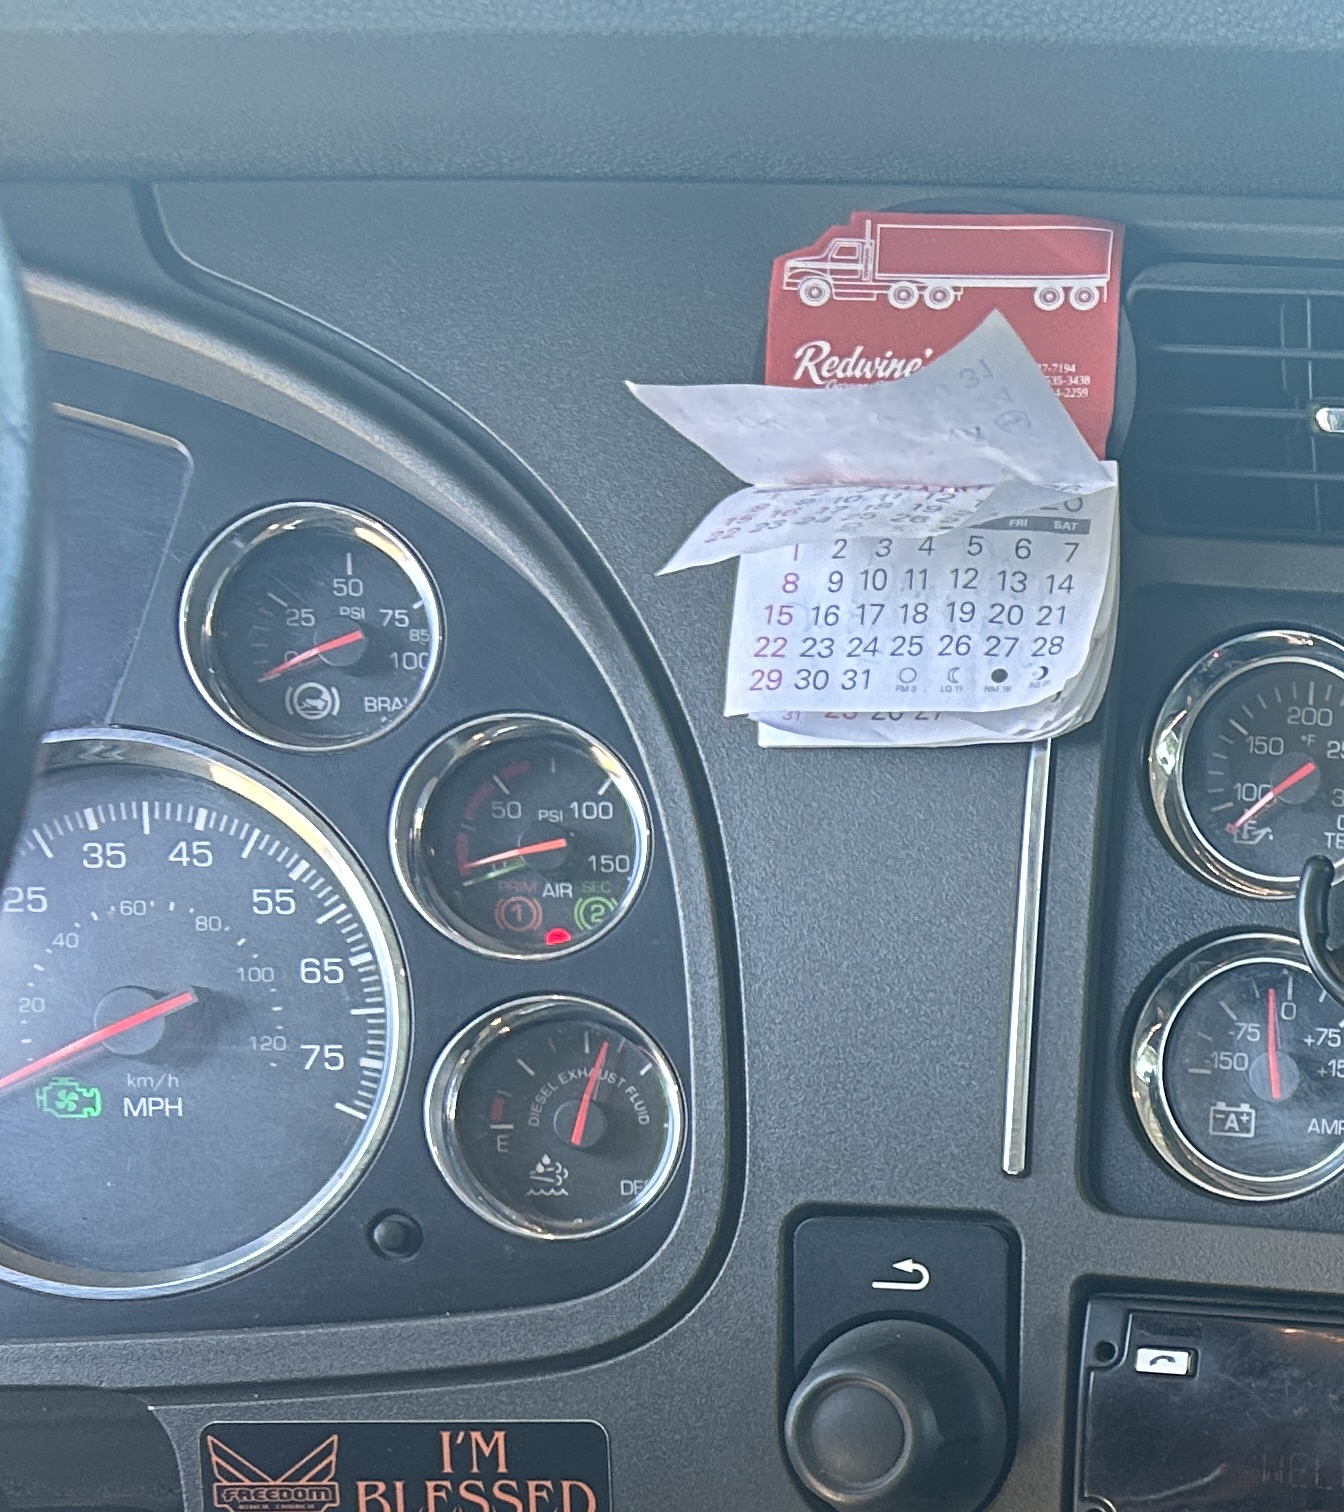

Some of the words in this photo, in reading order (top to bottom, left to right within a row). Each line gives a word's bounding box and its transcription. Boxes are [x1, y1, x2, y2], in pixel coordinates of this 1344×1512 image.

[793, 340, 933, 386] Redwine'
[1009, 518, 1028, 527] FRI
[1053, 520, 1079, 531] SAT
[831, 538, 849, 560] 2
[875, 538, 893, 558] 3
[917, 536, 936, 556] 4
[966, 535, 985, 556] 5
[1014, 538, 1033, 560] 6
[1064, 542, 1081, 563] 7
[333, 578, 363, 597] 50
[781, 572, 800, 595] 8
[827, 571, 845, 593] 9
[859, 568, 889, 592] 10
[904, 568, 929, 591] 11
[949, 567, 980, 590] 12
[997, 570, 1029, 594] 13
[1046, 573, 1075, 595] 14
[285, 609, 316, 627] 25
[339, 606, 366, 621] PSI
[379, 609, 409, 627] 75
[764, 604, 794, 627] 15
[811, 604, 841, 627] 16
[856, 603, 886, 626] 17
[900, 602, 930, 625] 18
[947, 602, 977, 624] 19
[988, 603, 1025, 627] 20
[1035, 605, 1067, 627] 21
[409, 628, 430, 643] 85
[753, 636, 788, 658] 22
[799, 636, 835, 659] 23
[846, 636, 880, 658] 24
[889, 635, 925, 658] 25
[937, 635, 972, 657] 26
[983, 636, 1020, 658] 27
[1031, 635, 1066, 658] 28
[749, 669, 783, 692] 29
[794, 669, 830, 691] 30
[841, 669, 872, 691] 31
[364, 696, 410, 713] BRA
[1287, 707, 1333, 727] 200
[1247, 736, 1284, 755] 150
[1233, 783, 1271, 801] 100
[491, 801, 522, 819] 50
[538, 809, 563, 822] PSI
[570, 801, 613, 820] 100
[82, 842, 127, 869] 35
[168, 841, 213, 867] 45
[588, 854, 630, 874] 150
[2, 886, 48, 913] 25
[542, 882, 572, 899] AIR
[120, 900, 147, 916] 60
[252, 888, 296, 915] 55
[511, 903, 524, 922] 1
[590, 903, 605, 922] 2
[195, 916, 221, 932] 80
[52, 933, 79, 948] 40
[237, 967, 275, 983] 100
[300, 958, 344, 985] 65
[18, 997, 46, 1013] 20
[1281, 1002, 1296, 1020] 0
[249, 1036, 286, 1051] 120
[1304, 1028, 1341, 1047] +75
[301, 1044, 344, 1071] 75
[126, 1072, 179, 1088] km/h
[123, 1097, 183, 1117] MPH
[528, 1081, 559, 1127] DIESEL
[624, 1085, 651, 1127] FLUID
[496, 1133, 509, 1153] E
[439, 1430, 509, 1474] I'M
